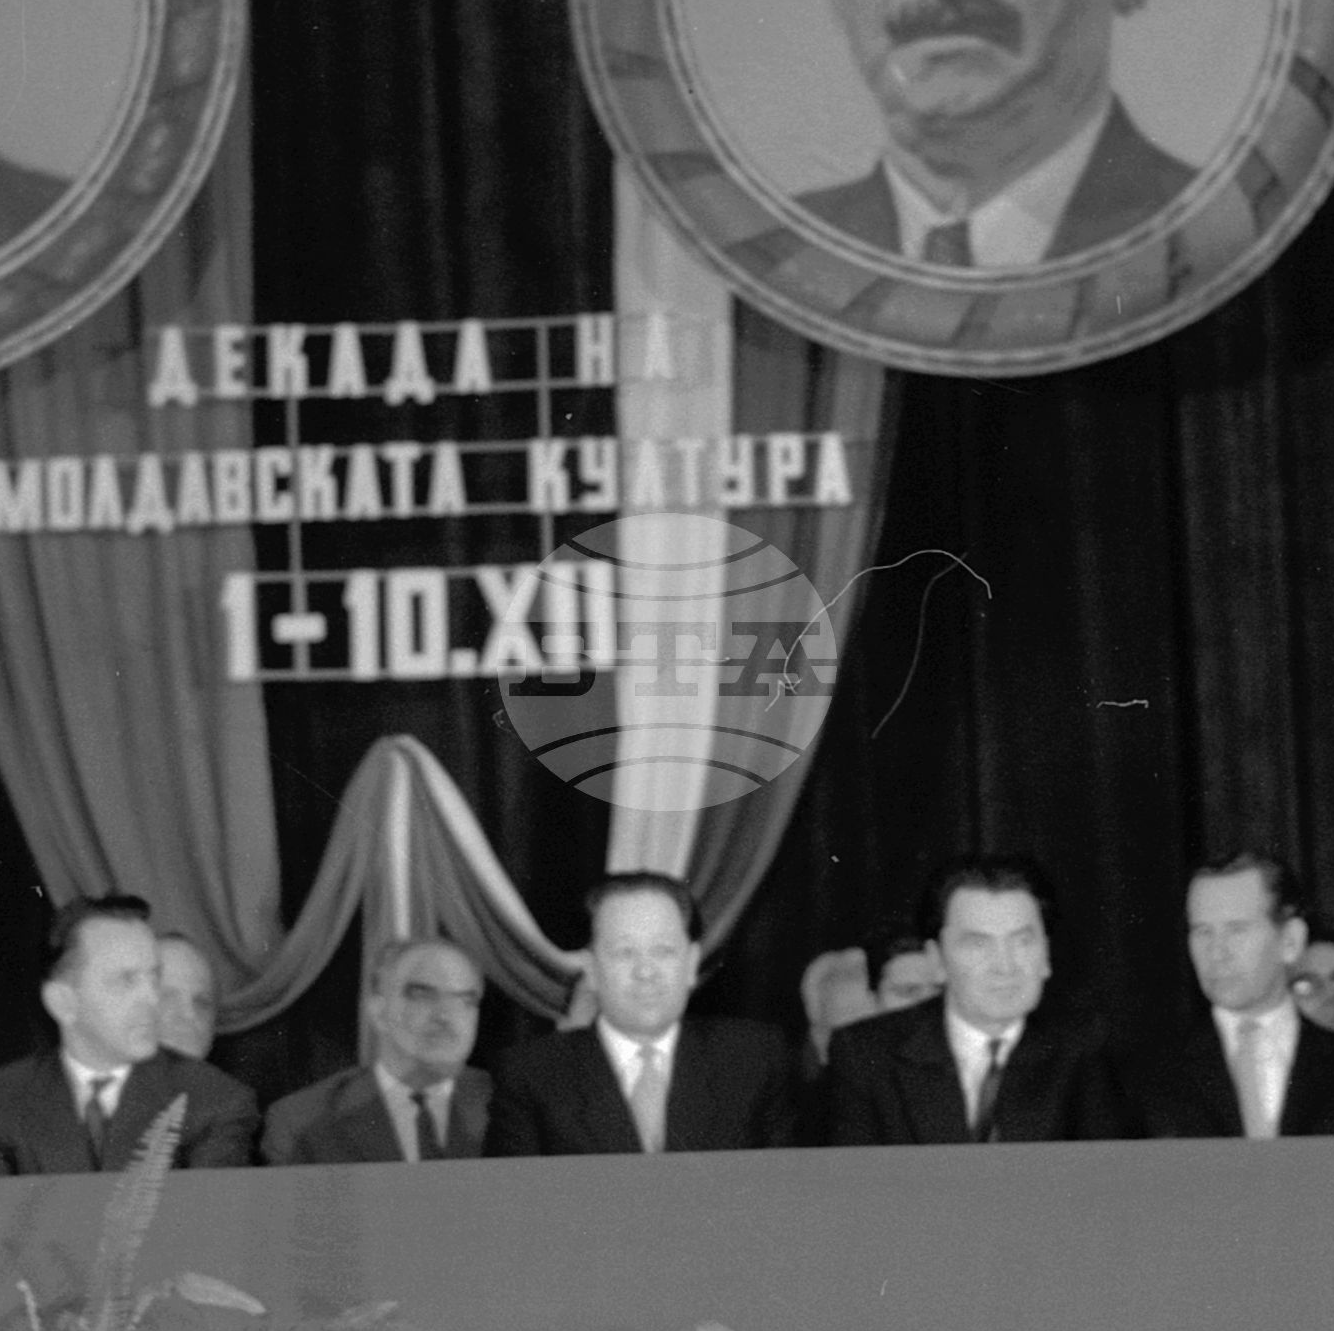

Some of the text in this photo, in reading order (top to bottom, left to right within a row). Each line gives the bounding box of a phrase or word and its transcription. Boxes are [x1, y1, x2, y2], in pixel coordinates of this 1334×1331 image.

[147, 311, 675, 407] ДЕКАДА НА
[527, 432, 853, 513] КУЛТУРА
